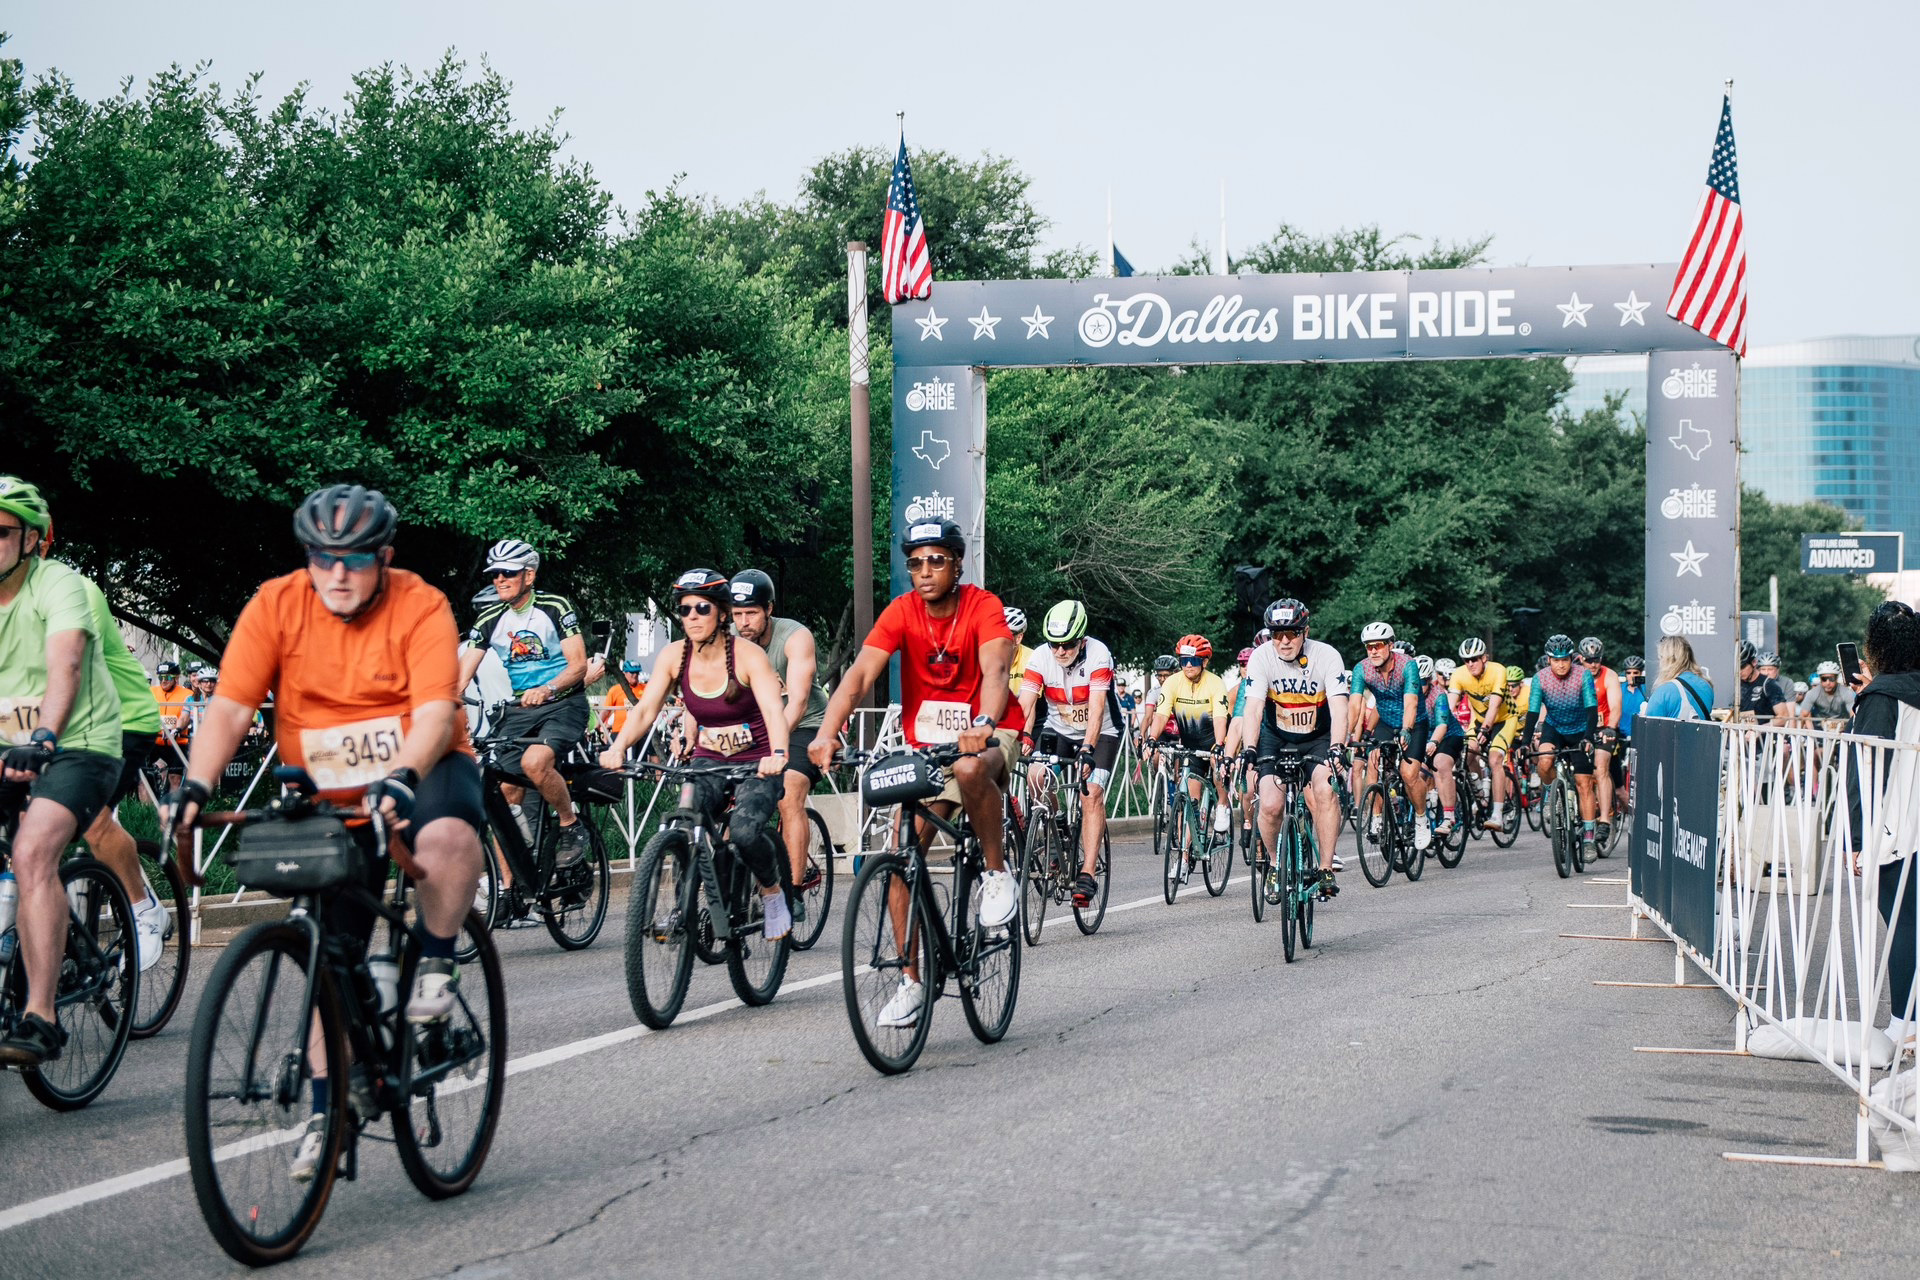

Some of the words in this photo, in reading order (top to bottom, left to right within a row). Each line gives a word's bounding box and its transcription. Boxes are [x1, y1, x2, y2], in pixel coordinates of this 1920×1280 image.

[1116, 292, 1279, 347] Dallas
[1292, 293, 1397, 340] BIKE
[1684, 369, 1717, 383] BIKE
[925, 382, 955, 397] BIKE
[925, 496, 955, 511] BIKE
[1683, 489, 1716, 503] BIKE
[1808, 548, 1875, 569] ADVANCED
[1682, 606, 1716, 620] BIKE
[1272, 678, 1318, 696] TEXAS
[936, 708, 969, 731] 4655
[1290, 710, 1315, 726] 1107
[342, 729, 400, 767] 3451
[870, 763, 915, 780] UNLIMITED
[870, 770, 917, 791] BIKING
